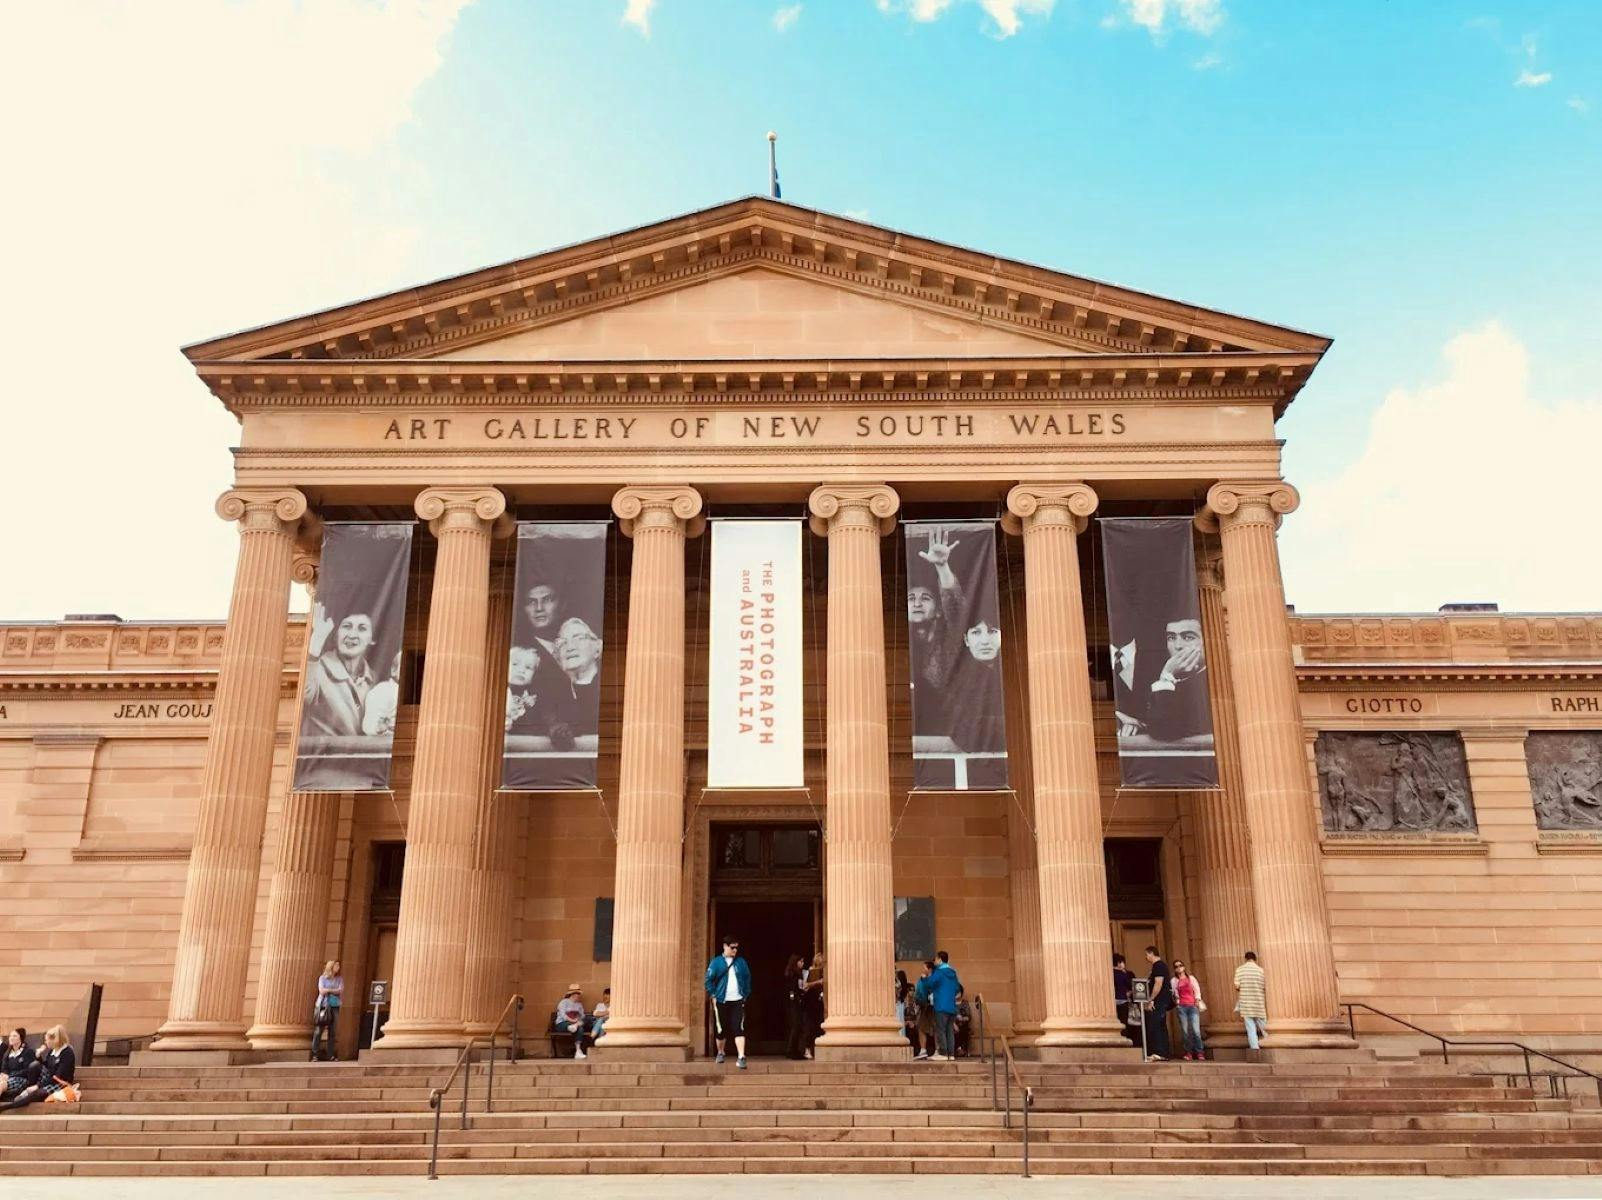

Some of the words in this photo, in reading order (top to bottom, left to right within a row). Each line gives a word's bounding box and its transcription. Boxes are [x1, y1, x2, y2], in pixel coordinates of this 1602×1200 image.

[384, 418, 451, 440] ART
[484, 418, 637, 440] GALLERY
[670, 418, 709, 438] OF
[743, 417, 821, 437] NEW
[856, 415, 975, 437] SOUTH
[1008, 413, 1126, 436] WALES
[742, 569, 752, 593] and
[762, 560, 772, 586] THE
[739, 600, 754, 734] AUSTRALIA
[759, 593, 775, 744] PHOTOGRAPH
[114, 704, 160, 719] JEAN
[166, 704, 213, 718] GOUJ
[1346, 698, 1422, 713] GIOTTO
[1550, 697, 1602, 711] RAPH
